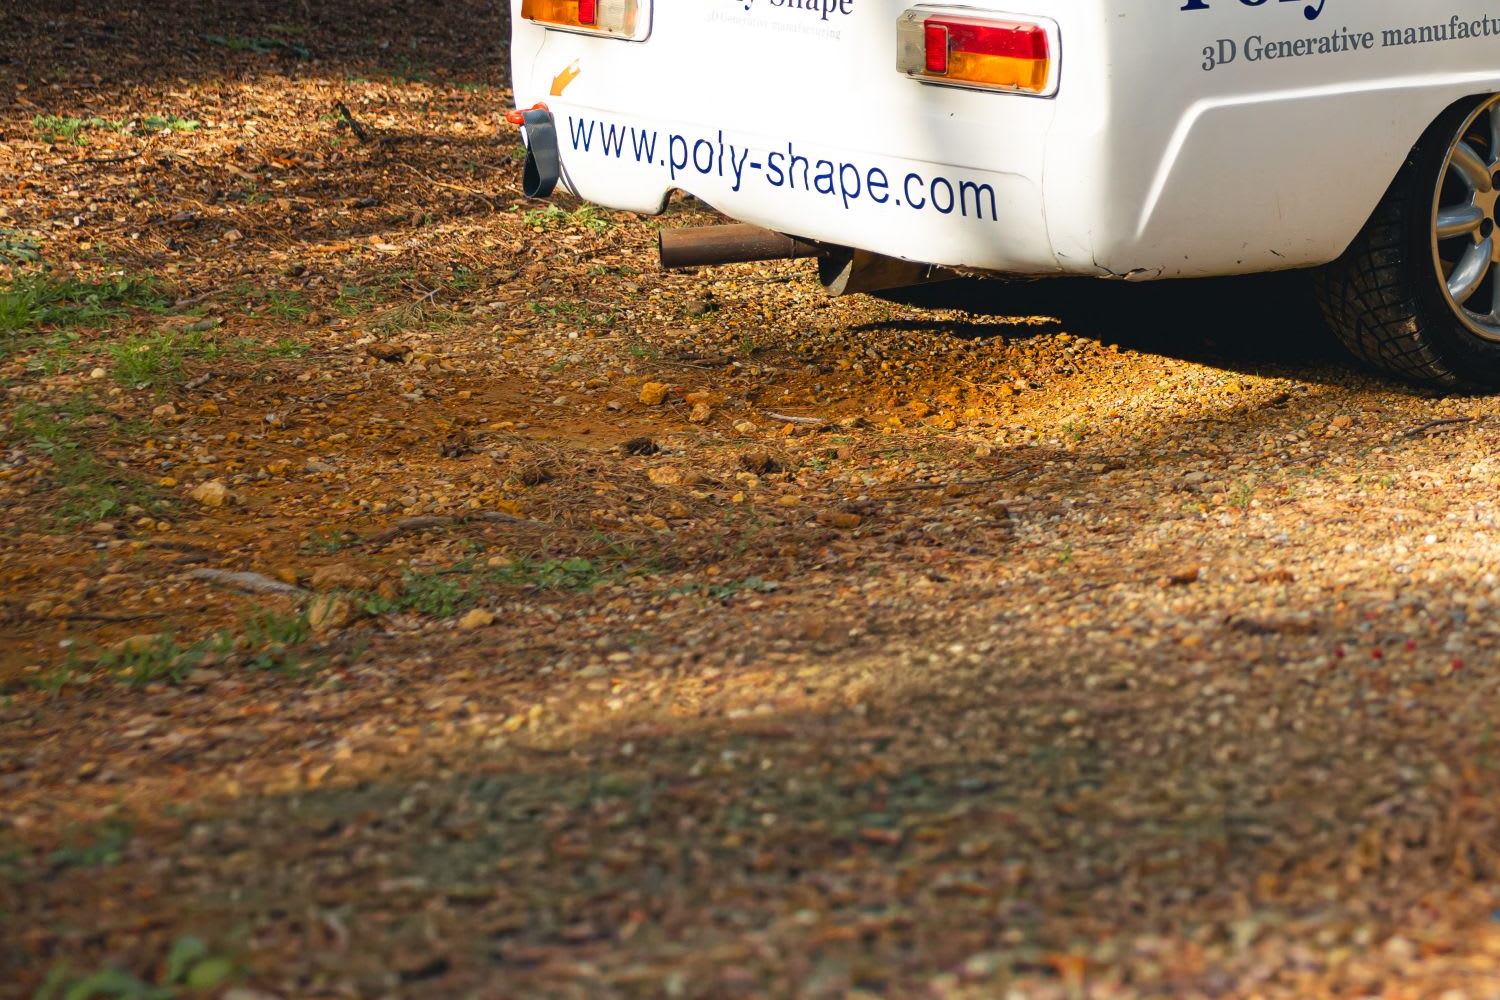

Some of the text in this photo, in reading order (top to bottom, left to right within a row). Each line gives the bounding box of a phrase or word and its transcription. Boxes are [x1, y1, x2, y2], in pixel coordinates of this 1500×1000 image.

[1201, 38, 1238, 71] 3D
[1243, 26, 1375, 63] Generative
[568, 115, 999, 223] www.poly-shape.com
